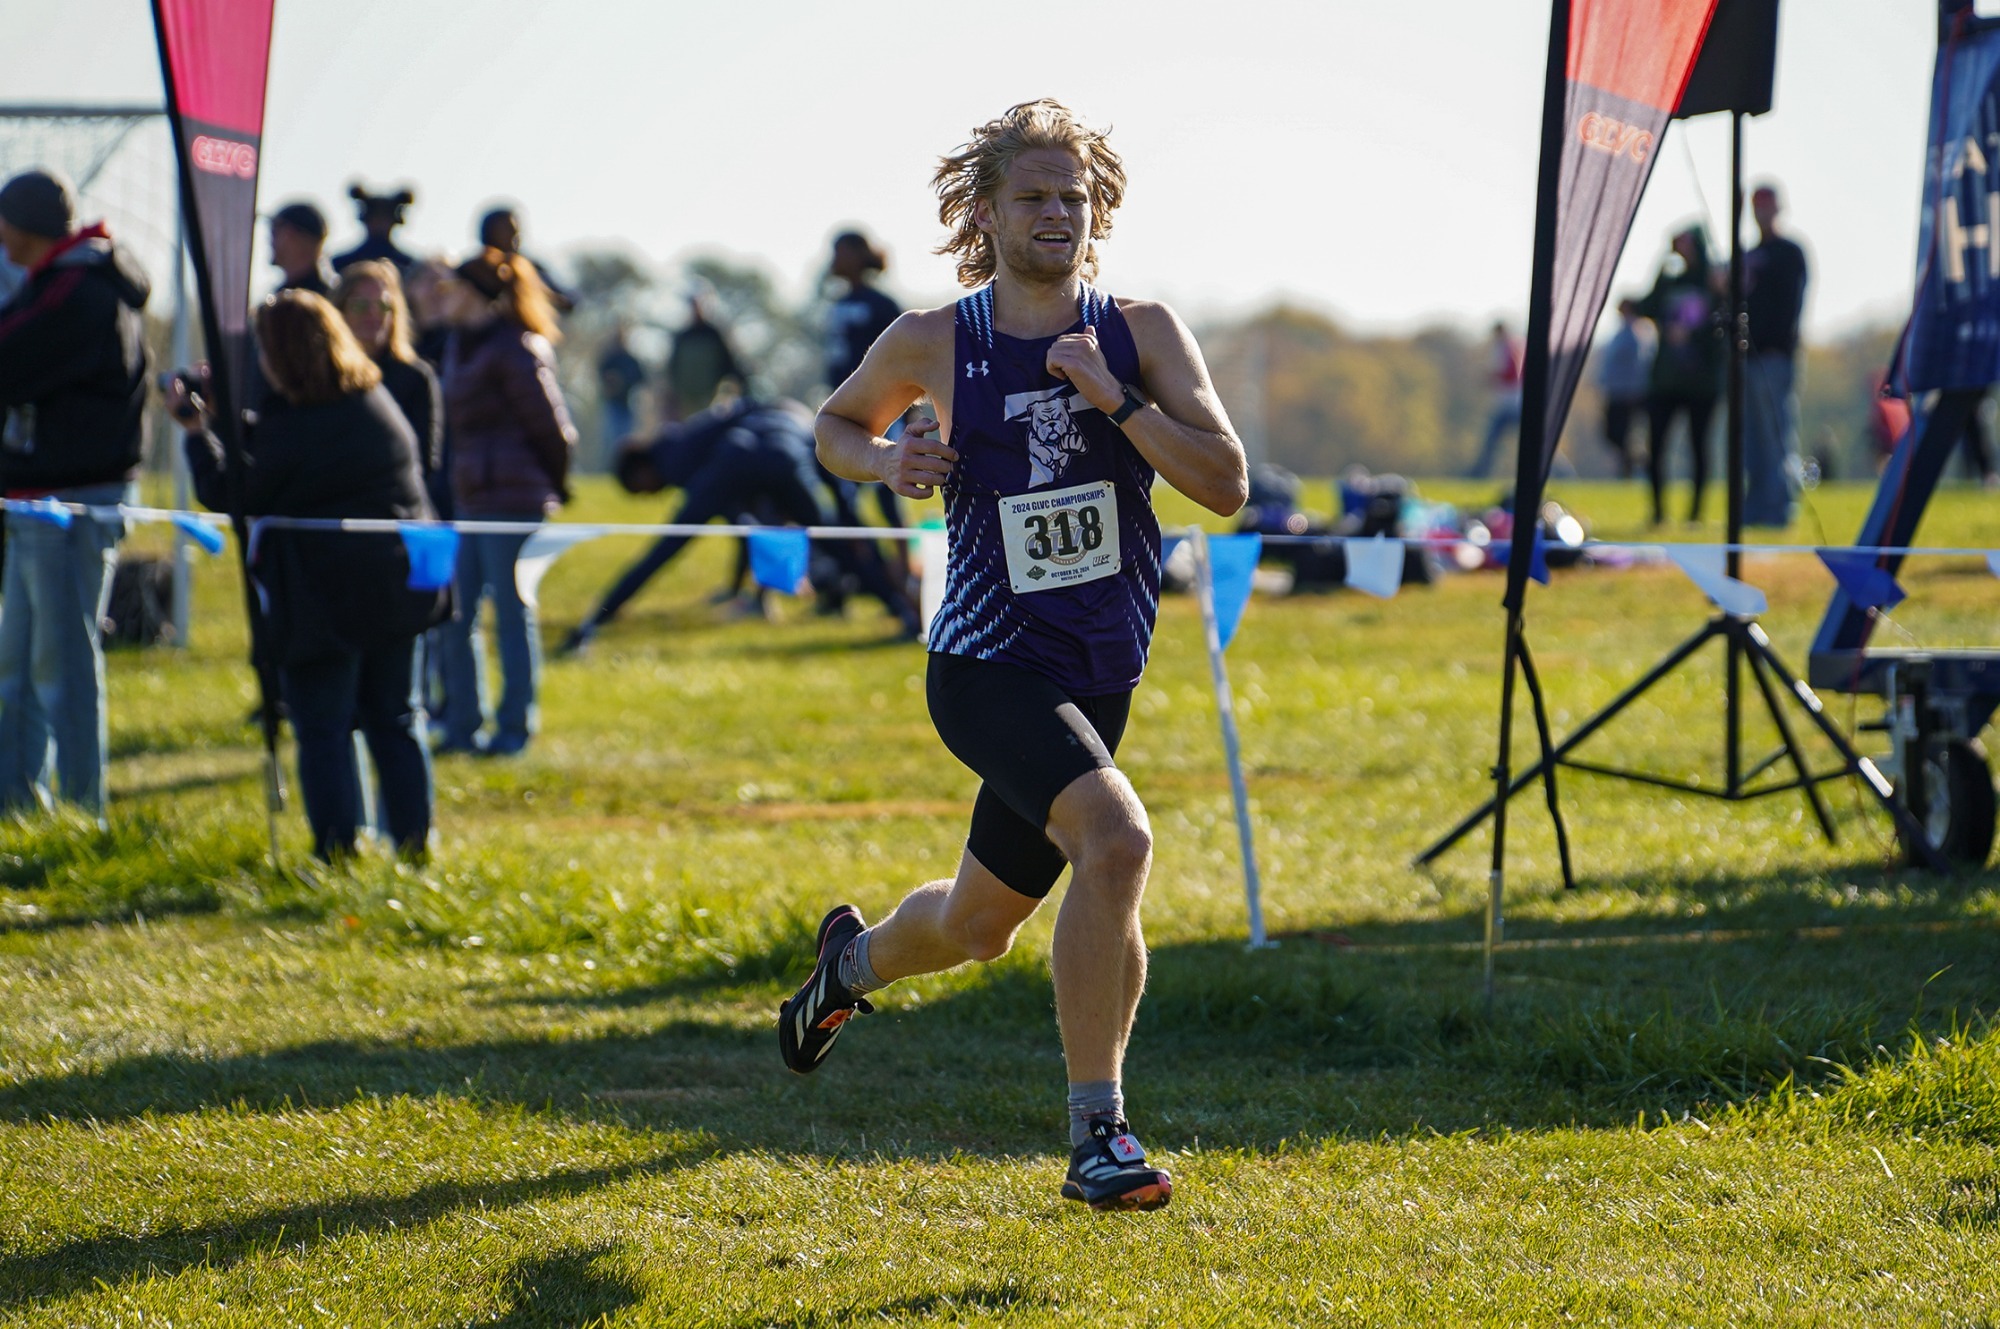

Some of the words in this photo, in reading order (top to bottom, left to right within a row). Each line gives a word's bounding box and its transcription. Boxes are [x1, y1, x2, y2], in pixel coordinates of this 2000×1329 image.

[1012, 502, 1031, 514] 2024
[1032, 499, 1050, 511] GLVC
[1051, 489, 1106, 508] CHAMPIONSHIPS
[1024, 505, 1103, 560] 318
[1050, 568, 1073, 579] OCTOBER
